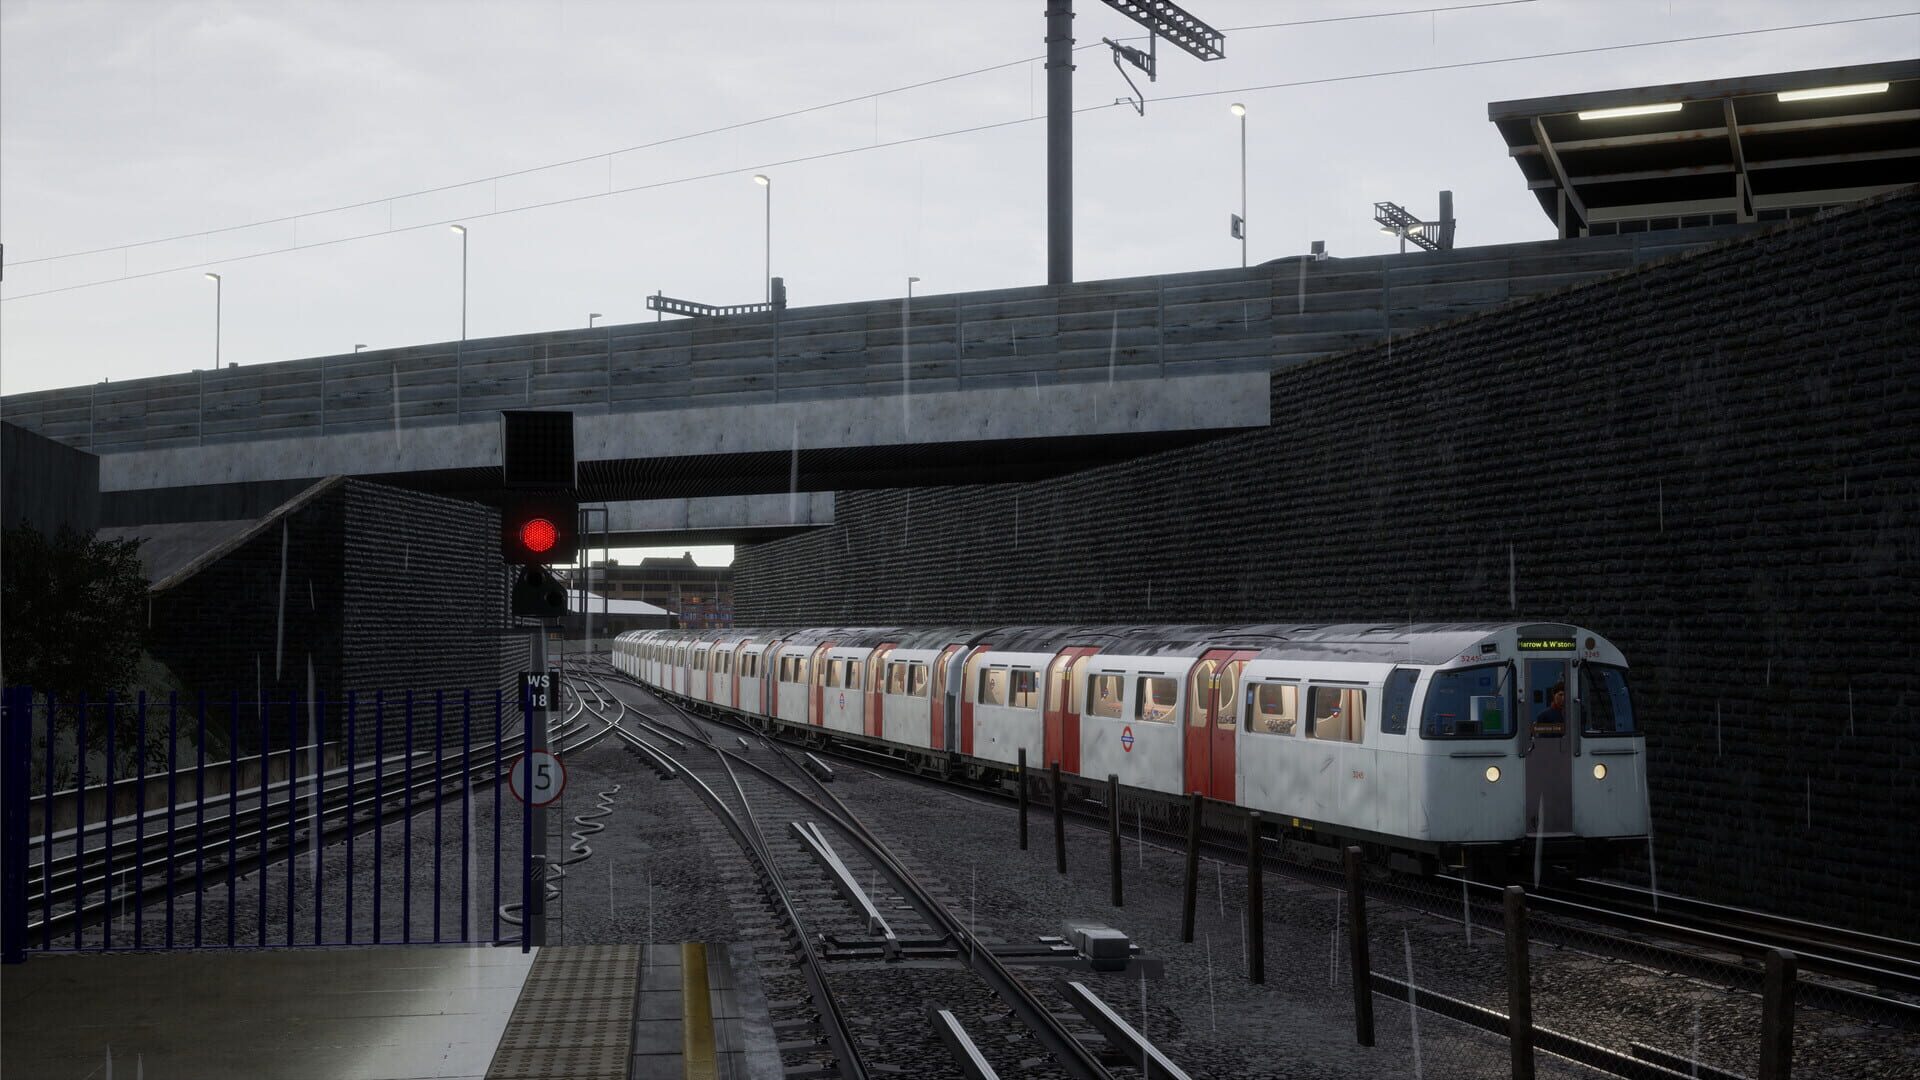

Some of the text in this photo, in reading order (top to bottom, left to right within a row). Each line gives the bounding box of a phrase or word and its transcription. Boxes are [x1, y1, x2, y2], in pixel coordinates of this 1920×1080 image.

[527, 675, 550, 688] WS
[532, 694, 547, 707] 18
[534, 764, 551, 790] 5
